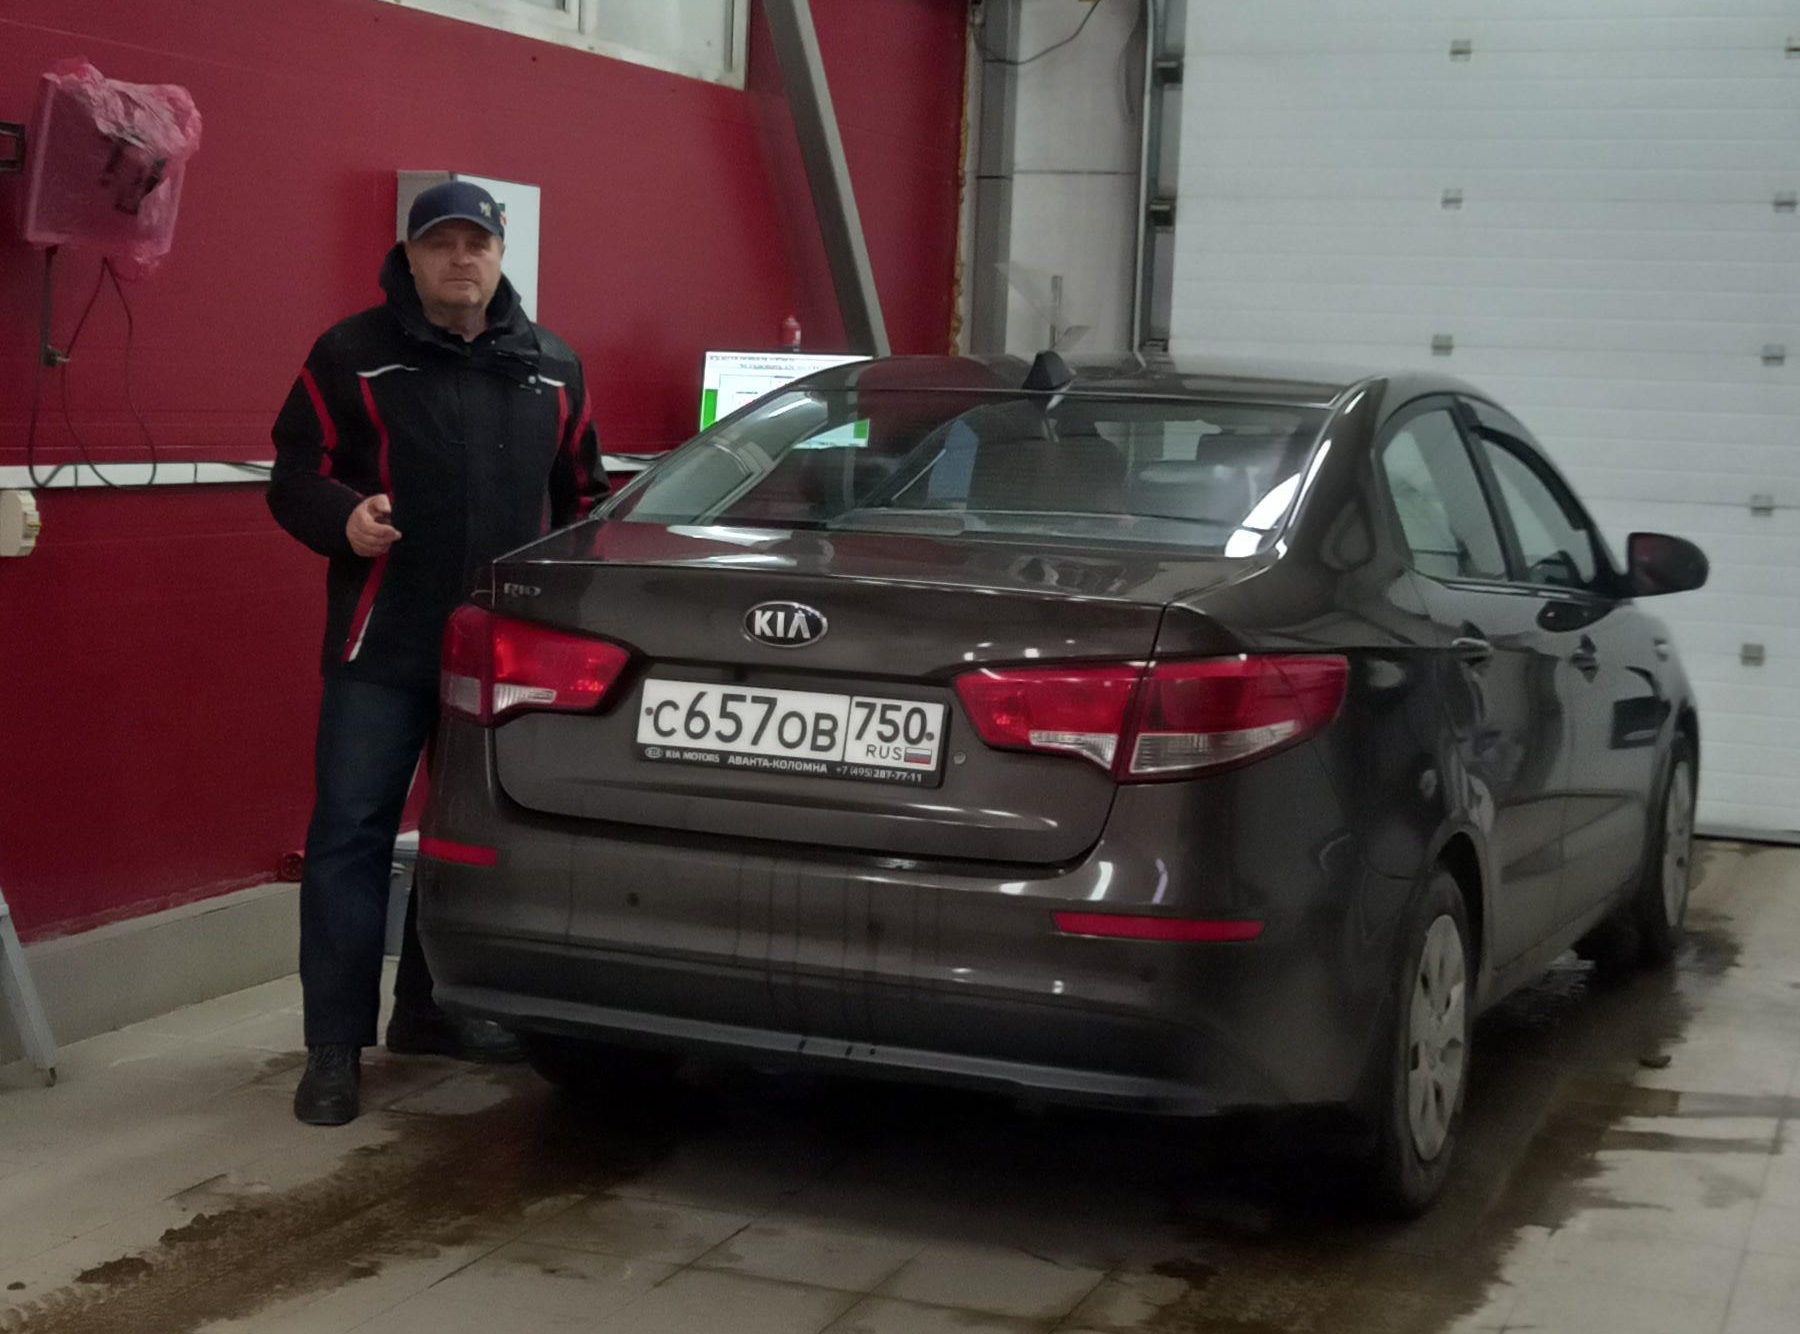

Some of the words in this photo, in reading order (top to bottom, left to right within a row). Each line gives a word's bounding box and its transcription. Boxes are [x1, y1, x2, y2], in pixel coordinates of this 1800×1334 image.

[753, 609, 812, 640] KIA
[653, 691, 839, 753] С657ОВ
[855, 701, 927, 746] 750
[665, 750, 681, 760] KIA
[683, 752, 720, 763] MOTORS
[728, 755, 828, 774] АВАНТА-КОЛОМНА
[866, 744, 903, 761] RUS
